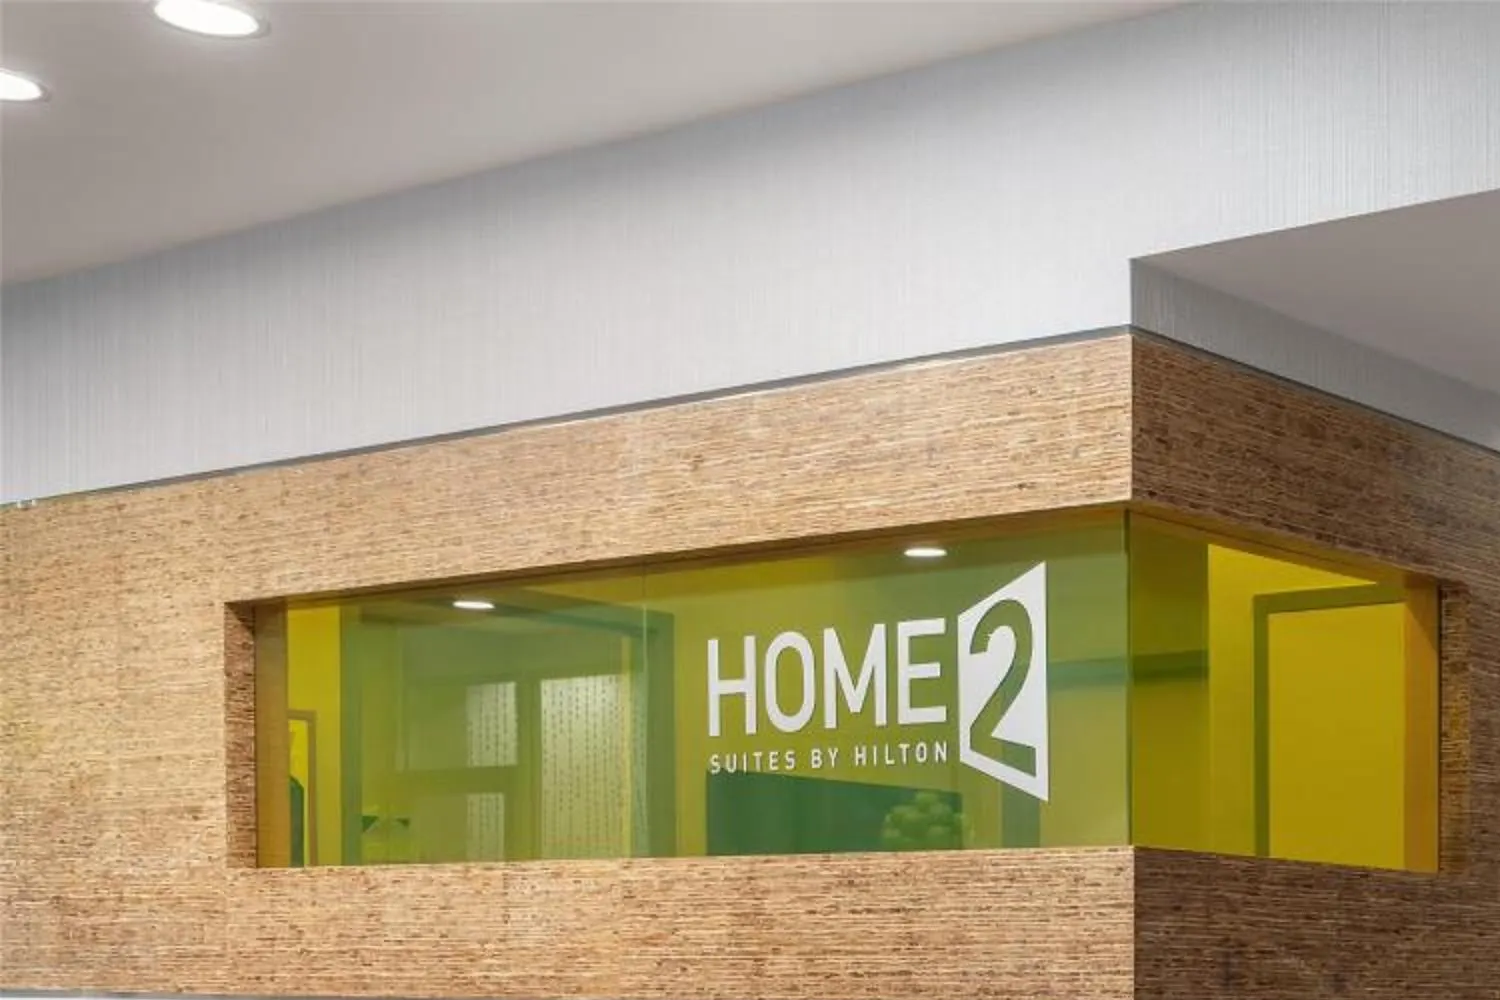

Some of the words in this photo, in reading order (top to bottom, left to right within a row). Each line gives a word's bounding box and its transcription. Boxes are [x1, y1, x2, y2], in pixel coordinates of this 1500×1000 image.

[710, 750, 796, 774] SUITES
[811, 746, 838, 768] BY
[854, 741, 949, 766] HILTON
